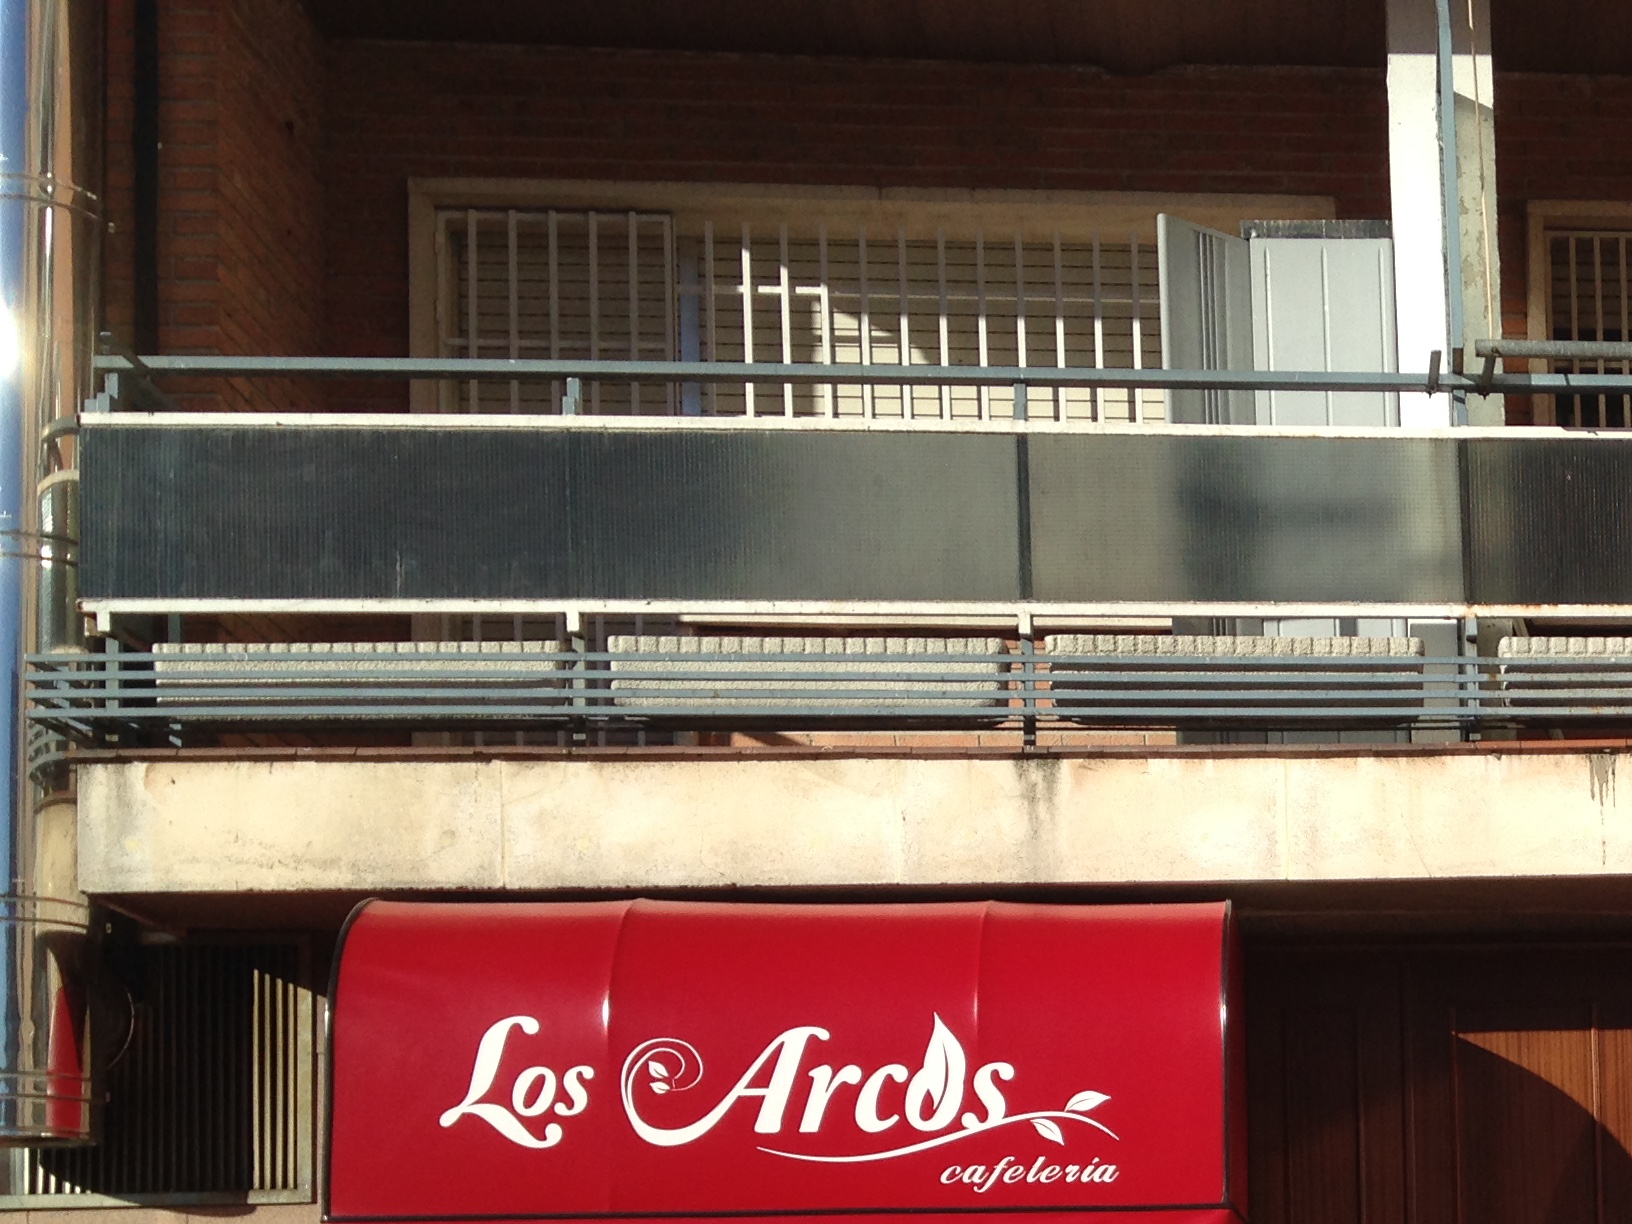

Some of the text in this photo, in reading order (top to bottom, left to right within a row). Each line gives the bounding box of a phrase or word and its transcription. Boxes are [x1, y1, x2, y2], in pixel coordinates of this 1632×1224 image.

[439, 1012, 1016, 1149] Los Arcos
[939, 1155, 1121, 1194] cafetería
